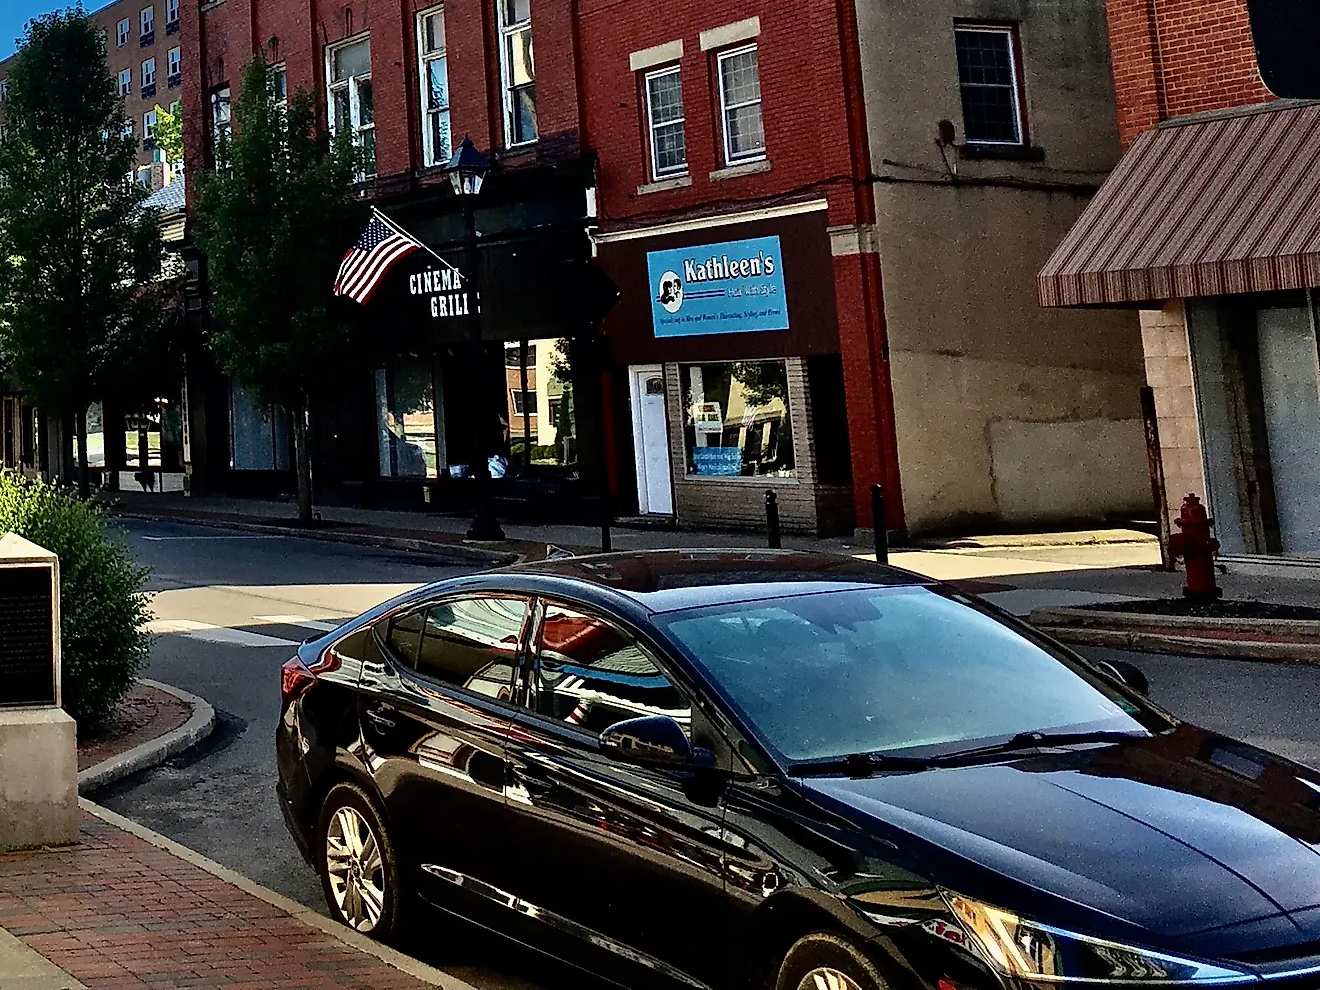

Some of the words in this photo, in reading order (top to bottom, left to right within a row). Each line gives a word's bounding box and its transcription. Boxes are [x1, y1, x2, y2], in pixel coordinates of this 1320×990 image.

[684, 250, 775, 283] Kathleen's
[410, 268, 461, 295] CINEMA
[431, 292, 481, 317] GRILL
